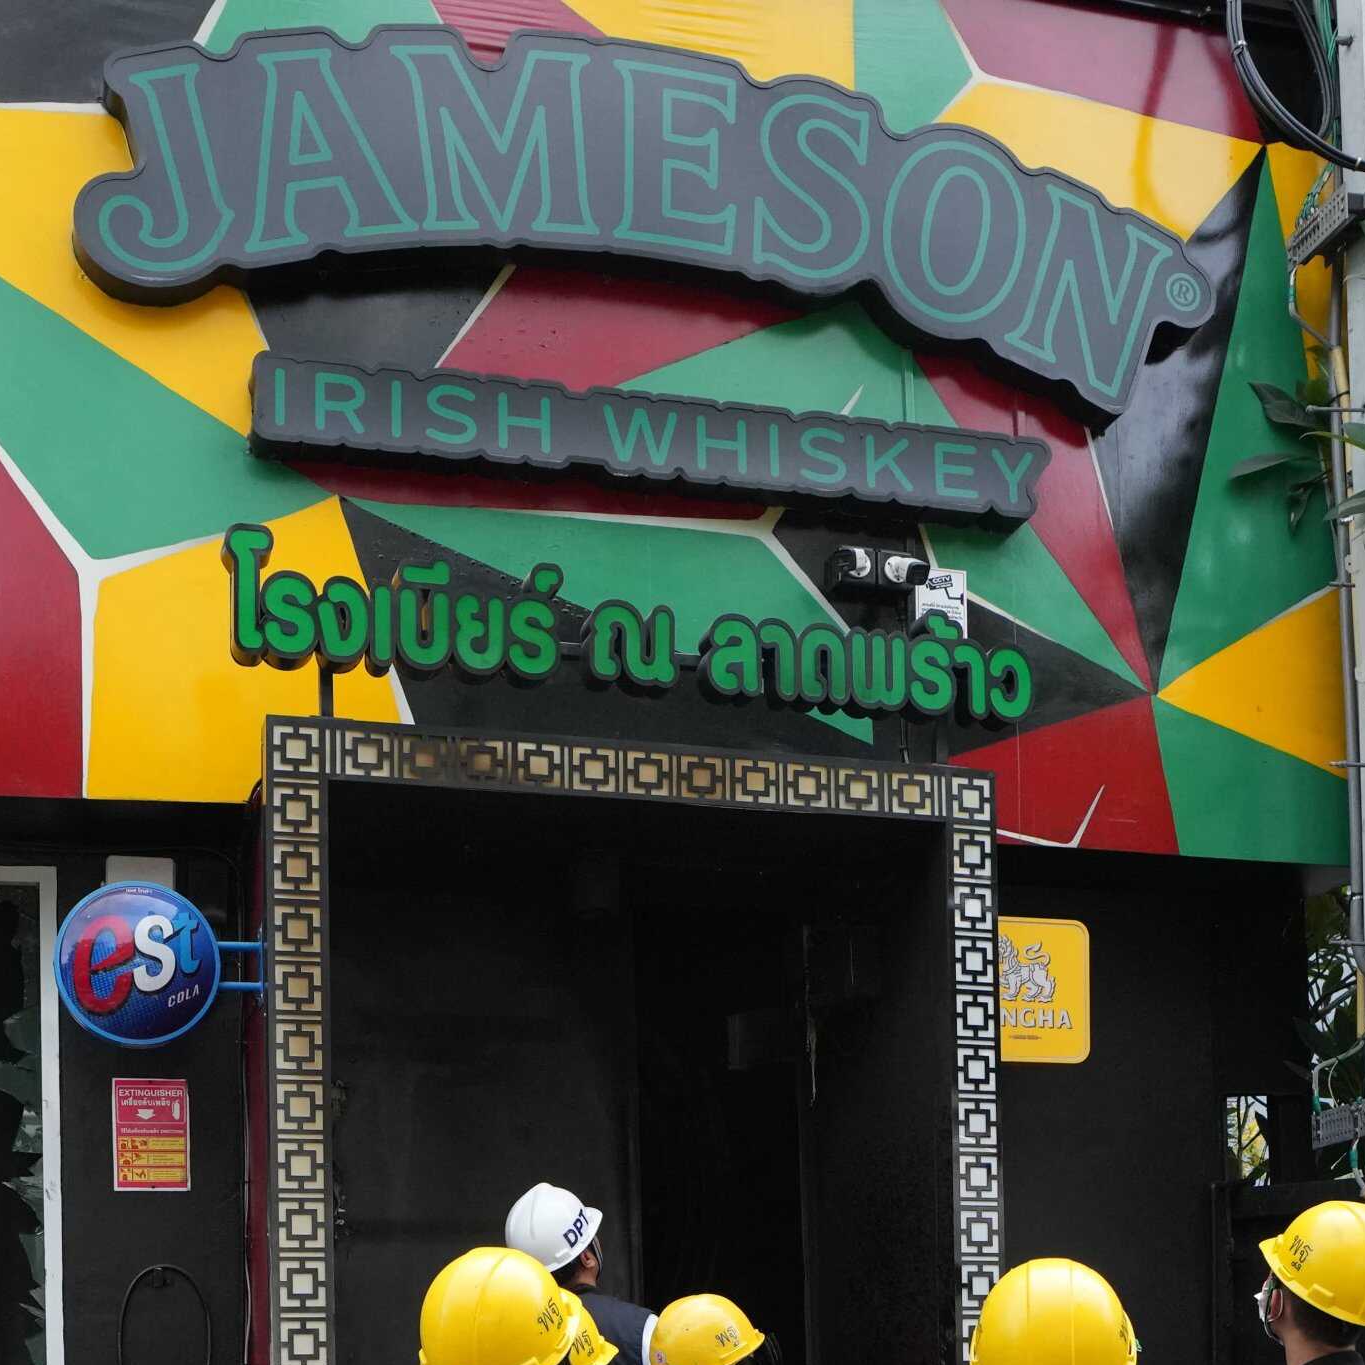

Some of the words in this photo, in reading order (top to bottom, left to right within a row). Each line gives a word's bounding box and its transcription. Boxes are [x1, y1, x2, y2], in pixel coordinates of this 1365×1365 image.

[274, 366, 552, 454] IRISH
[602, 402, 1034, 504] WHISKEY
[227, 526, 561, 677] โรงเบียร์
[591, 602, 677, 685] ณ
[708, 612, 1033, 718] ลาดพร้าว
[73, 911, 201, 1013] est
[167, 984, 200, 1008] COLA
[1001, 1007, 1073, 1029] NGHA
[118, 1089, 184, 1097] EXTINGUISHER
[562, 1208, 590, 1249] DPT
